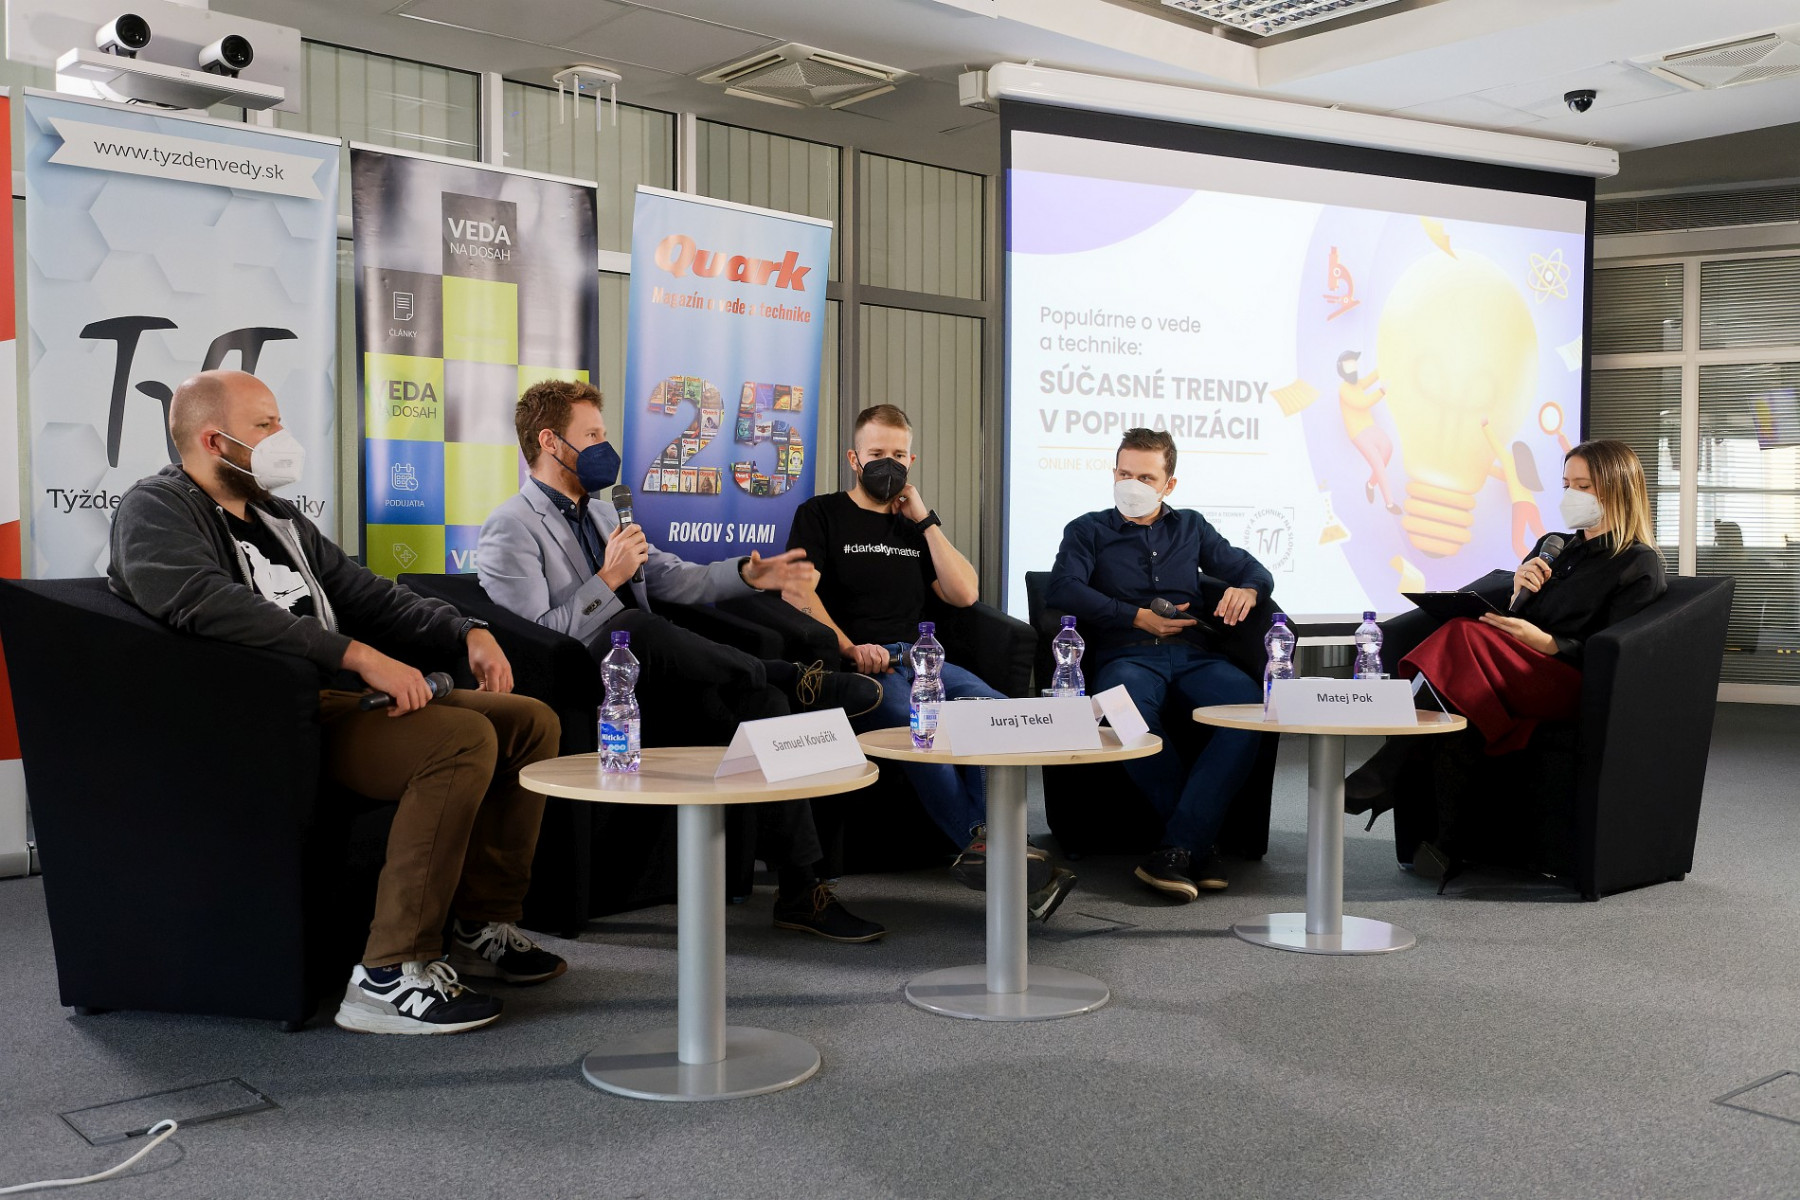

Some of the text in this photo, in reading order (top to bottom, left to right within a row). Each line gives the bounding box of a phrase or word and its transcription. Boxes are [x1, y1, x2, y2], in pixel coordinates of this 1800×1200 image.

[93, 140, 284, 180] www.tyzdenvedy.sk
[448, 217, 512, 246] VEDA
[450, 242, 511, 261] NA DOSAH
[655, 234, 811, 291] Quark
[652, 286, 811, 323] Magazín o vede a technike
[1040, 306, 1202, 334] Populárne o vede
[1040, 332, 1144, 356] a technike:
[1040, 362, 1269, 404] SÚČASNÉ TRENDY
[392, 405, 437, 419] DOSAH
[1039, 408, 1060, 433] V
[1039, 456, 1082, 471] ONLINE
[46, 488, 121, 514] Týžde
[385, 498, 426, 509] PODUJATIA
[668, 521, 776, 544] ROKOV S VAMI
[843, 543, 921, 558] #darkskymatter
[1317, 693, 1373, 705] Matej Pok
[990, 713, 1053, 728] Juraj Tekel
[772, 730, 838, 752] Samuel Kováčik
